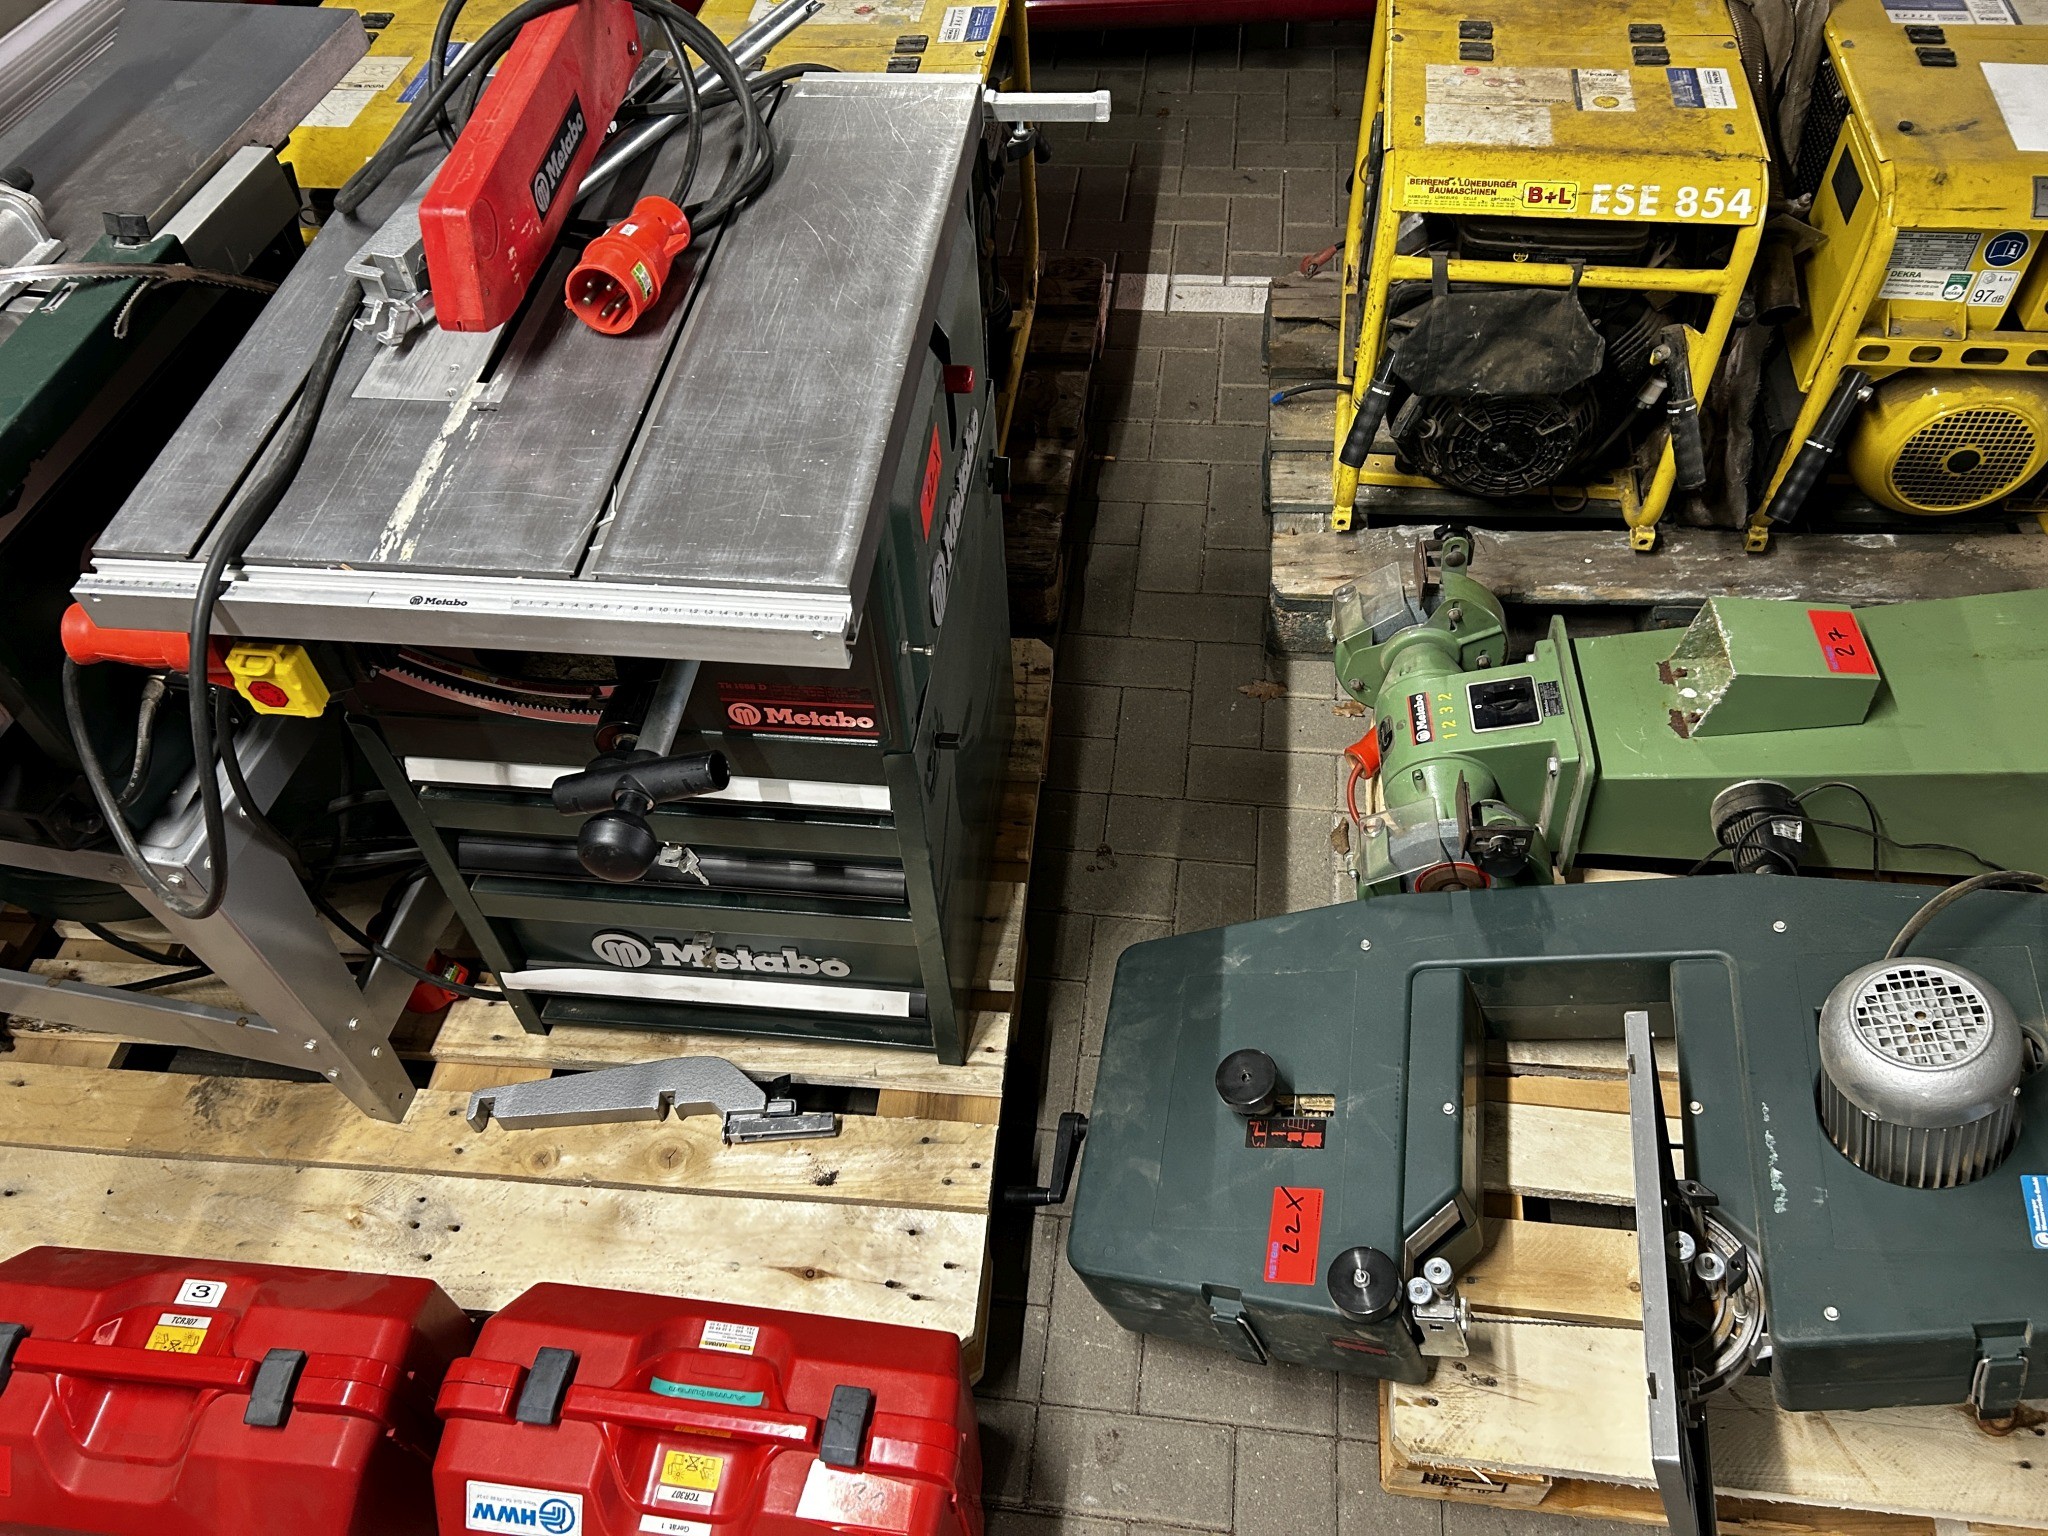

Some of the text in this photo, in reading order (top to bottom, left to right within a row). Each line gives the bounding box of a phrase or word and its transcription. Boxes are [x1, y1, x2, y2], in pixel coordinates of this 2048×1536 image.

[545, 112, 584, 190] Metabo
[1409, 178, 1450, 186] BEHRENS
[1458, 178, 1518, 188] LÜNEBURGER
[1428, 186, 1498, 196] BAUMASCHINEN
[1527, 186, 1572, 204] B+L
[1590, 183, 1753, 219] ESE 854
[1890, 270, 1922, 278] DEKRA
[1973, 289, 2005, 303] 97 dB
[423, 597, 468, 606] Metabo
[1827, 626, 1856, 657] 27
[763, 707, 875, 729] Metabo
[1413, 694, 1428, 731] Metabo
[653, 939, 851, 978] Metabo
[1268, 1241, 1279, 1280] NETBID
[191, 1285, 212, 1298] 3
[171, 1316, 198, 1326] TCR307
[704, 1340, 728, 1349] HARMS
[670, 1490, 700, 1502] TCR307
[472, 1502, 537, 1527] HWW
[669, 1523, 690, 1533] Gerät
